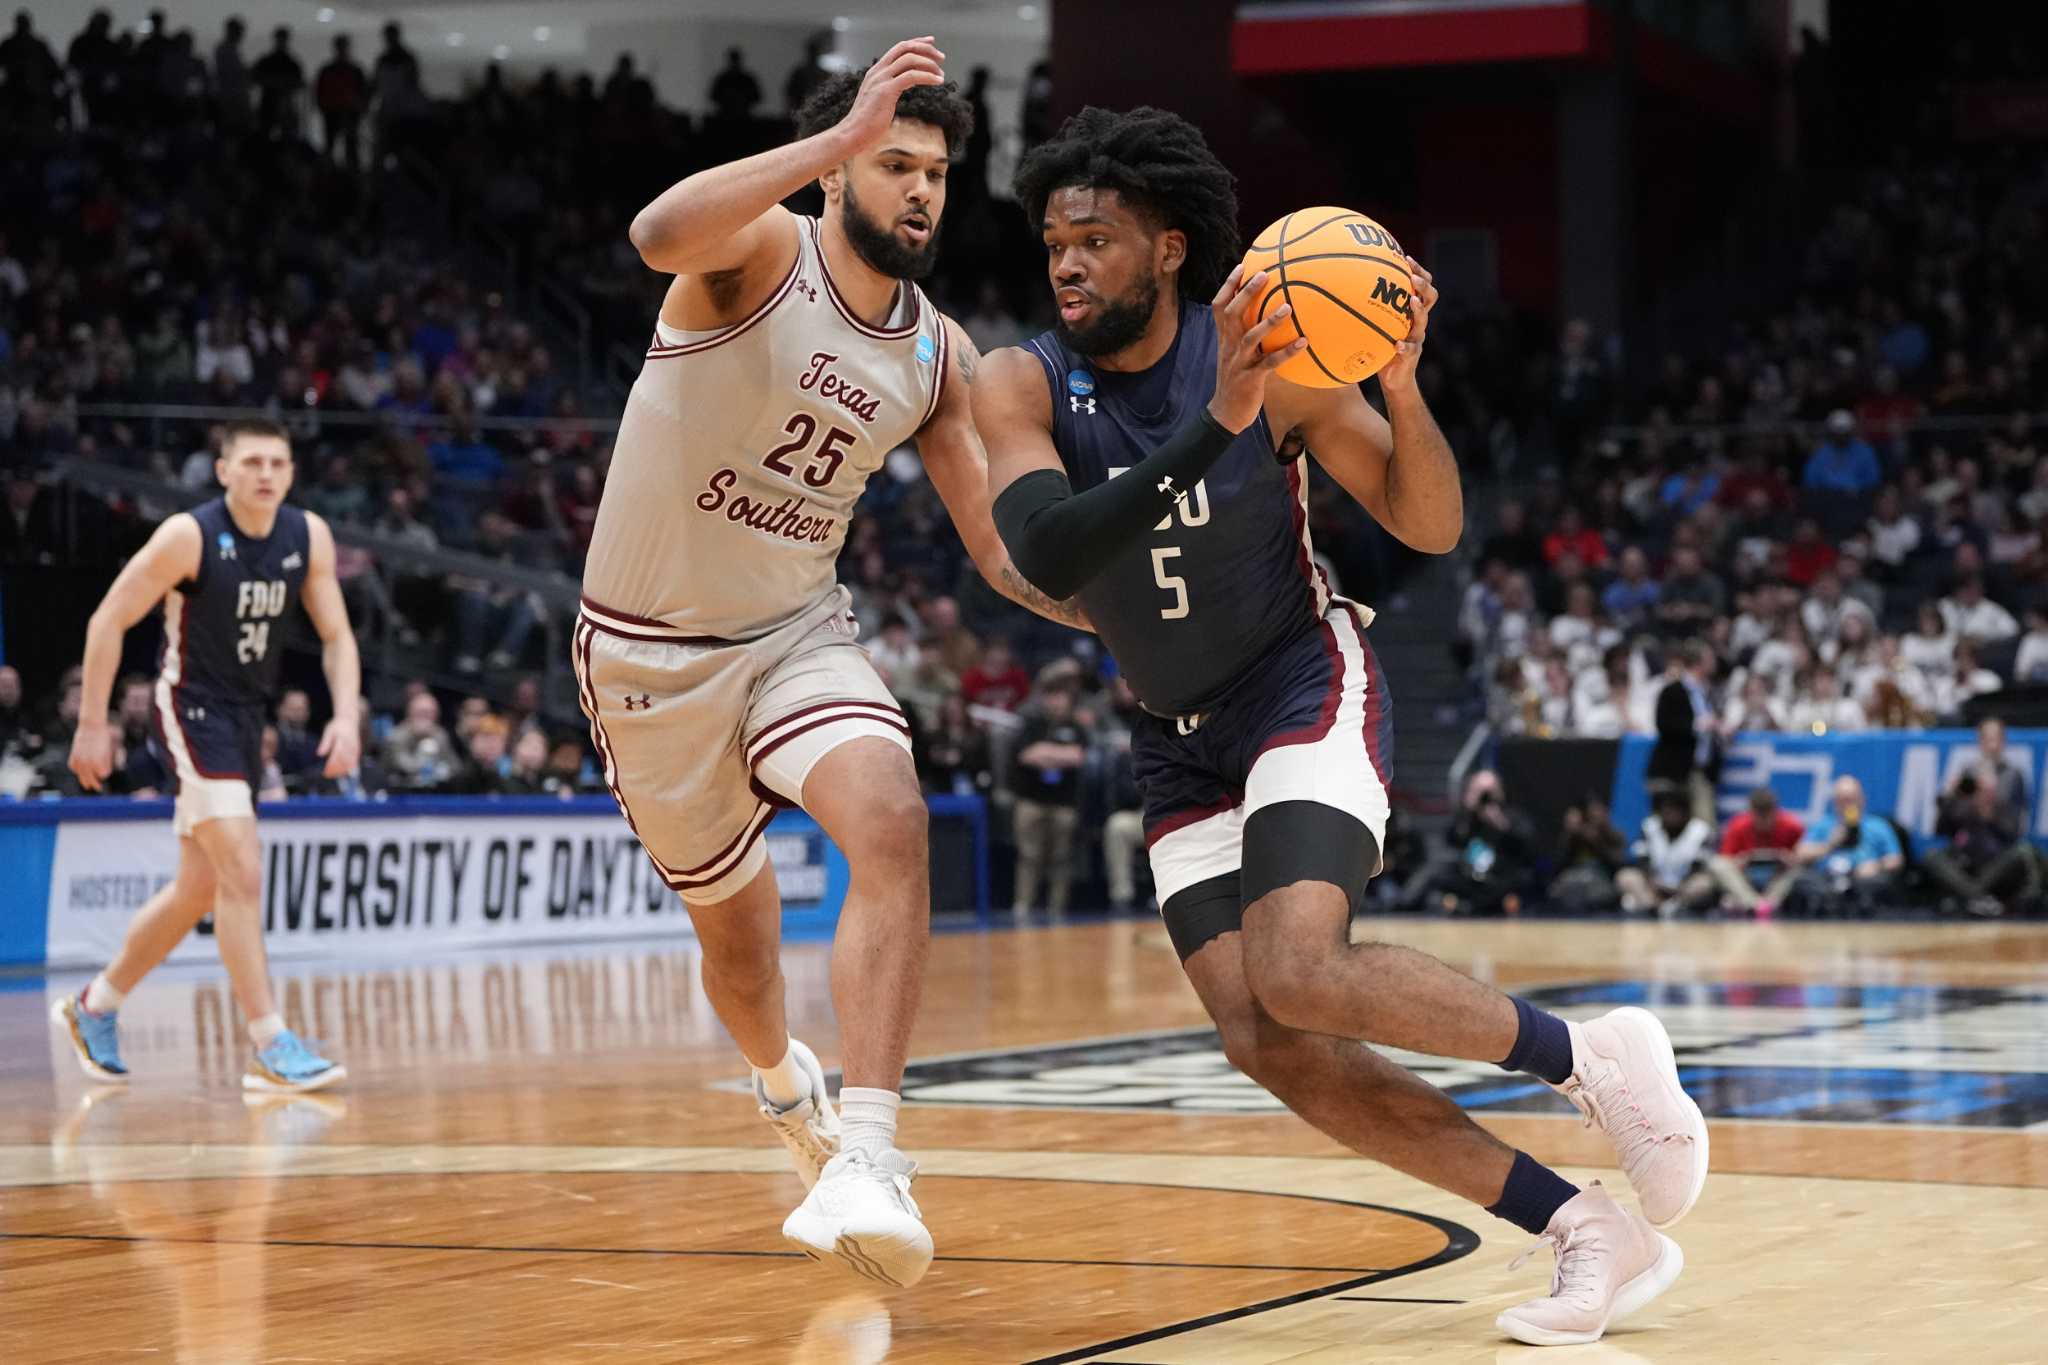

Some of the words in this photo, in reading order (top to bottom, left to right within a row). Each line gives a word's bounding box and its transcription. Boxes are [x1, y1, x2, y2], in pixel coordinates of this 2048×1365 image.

[1370, 276, 1414, 321] NCA
[799, 352, 881, 423] Texas
[762, 413, 857, 487] 25
[696, 469, 835, 544] Southern
[236, 580, 287, 619] FDU
[1150, 546, 1191, 620] 5
[236, 621, 270, 665] 24
[196, 839, 471, 935] IVERSITY
[484, 839, 536, 922] OF
